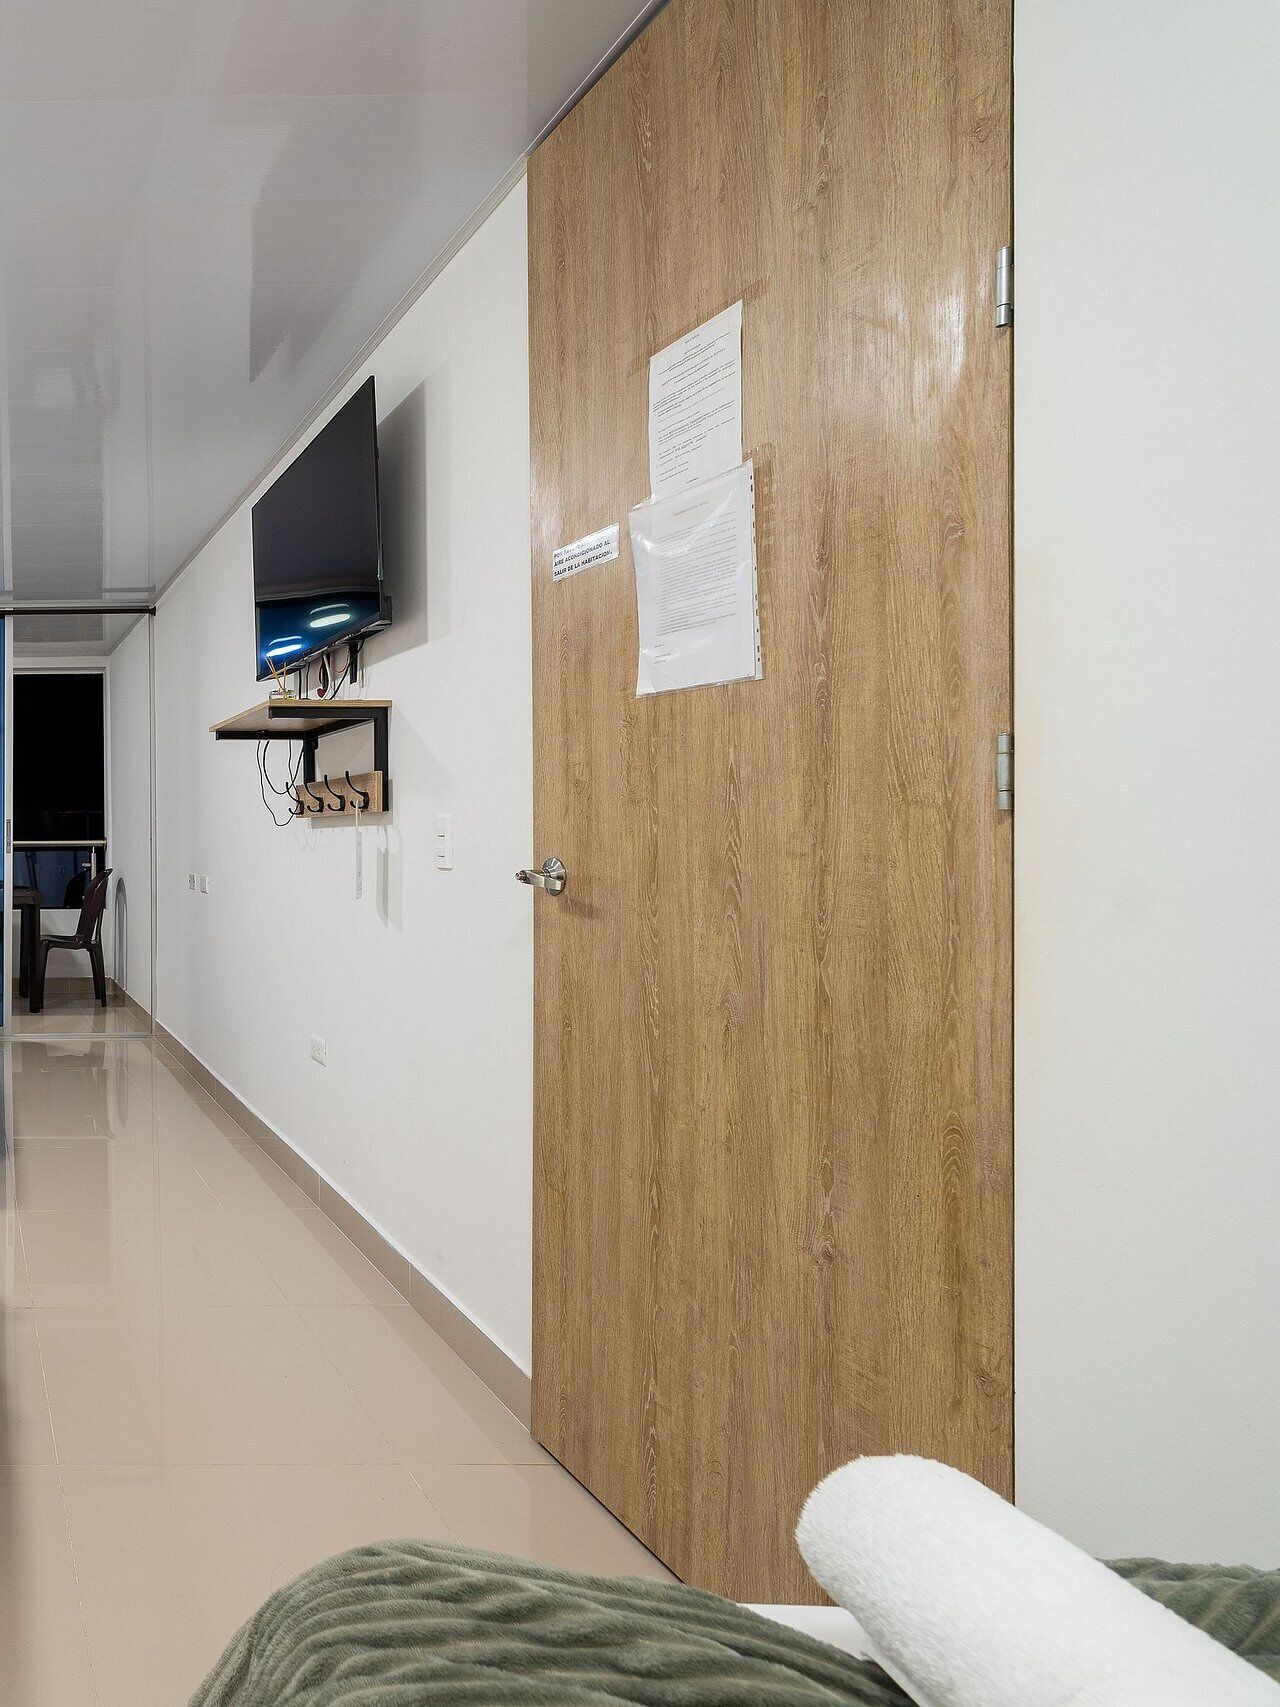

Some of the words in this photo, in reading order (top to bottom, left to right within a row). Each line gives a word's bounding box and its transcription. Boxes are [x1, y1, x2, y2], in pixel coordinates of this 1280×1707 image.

[554, 559, 564, 567] AIRE
[565, 543, 603, 562] ACONDICIONADO
[554, 568, 567, 577] SALIR
